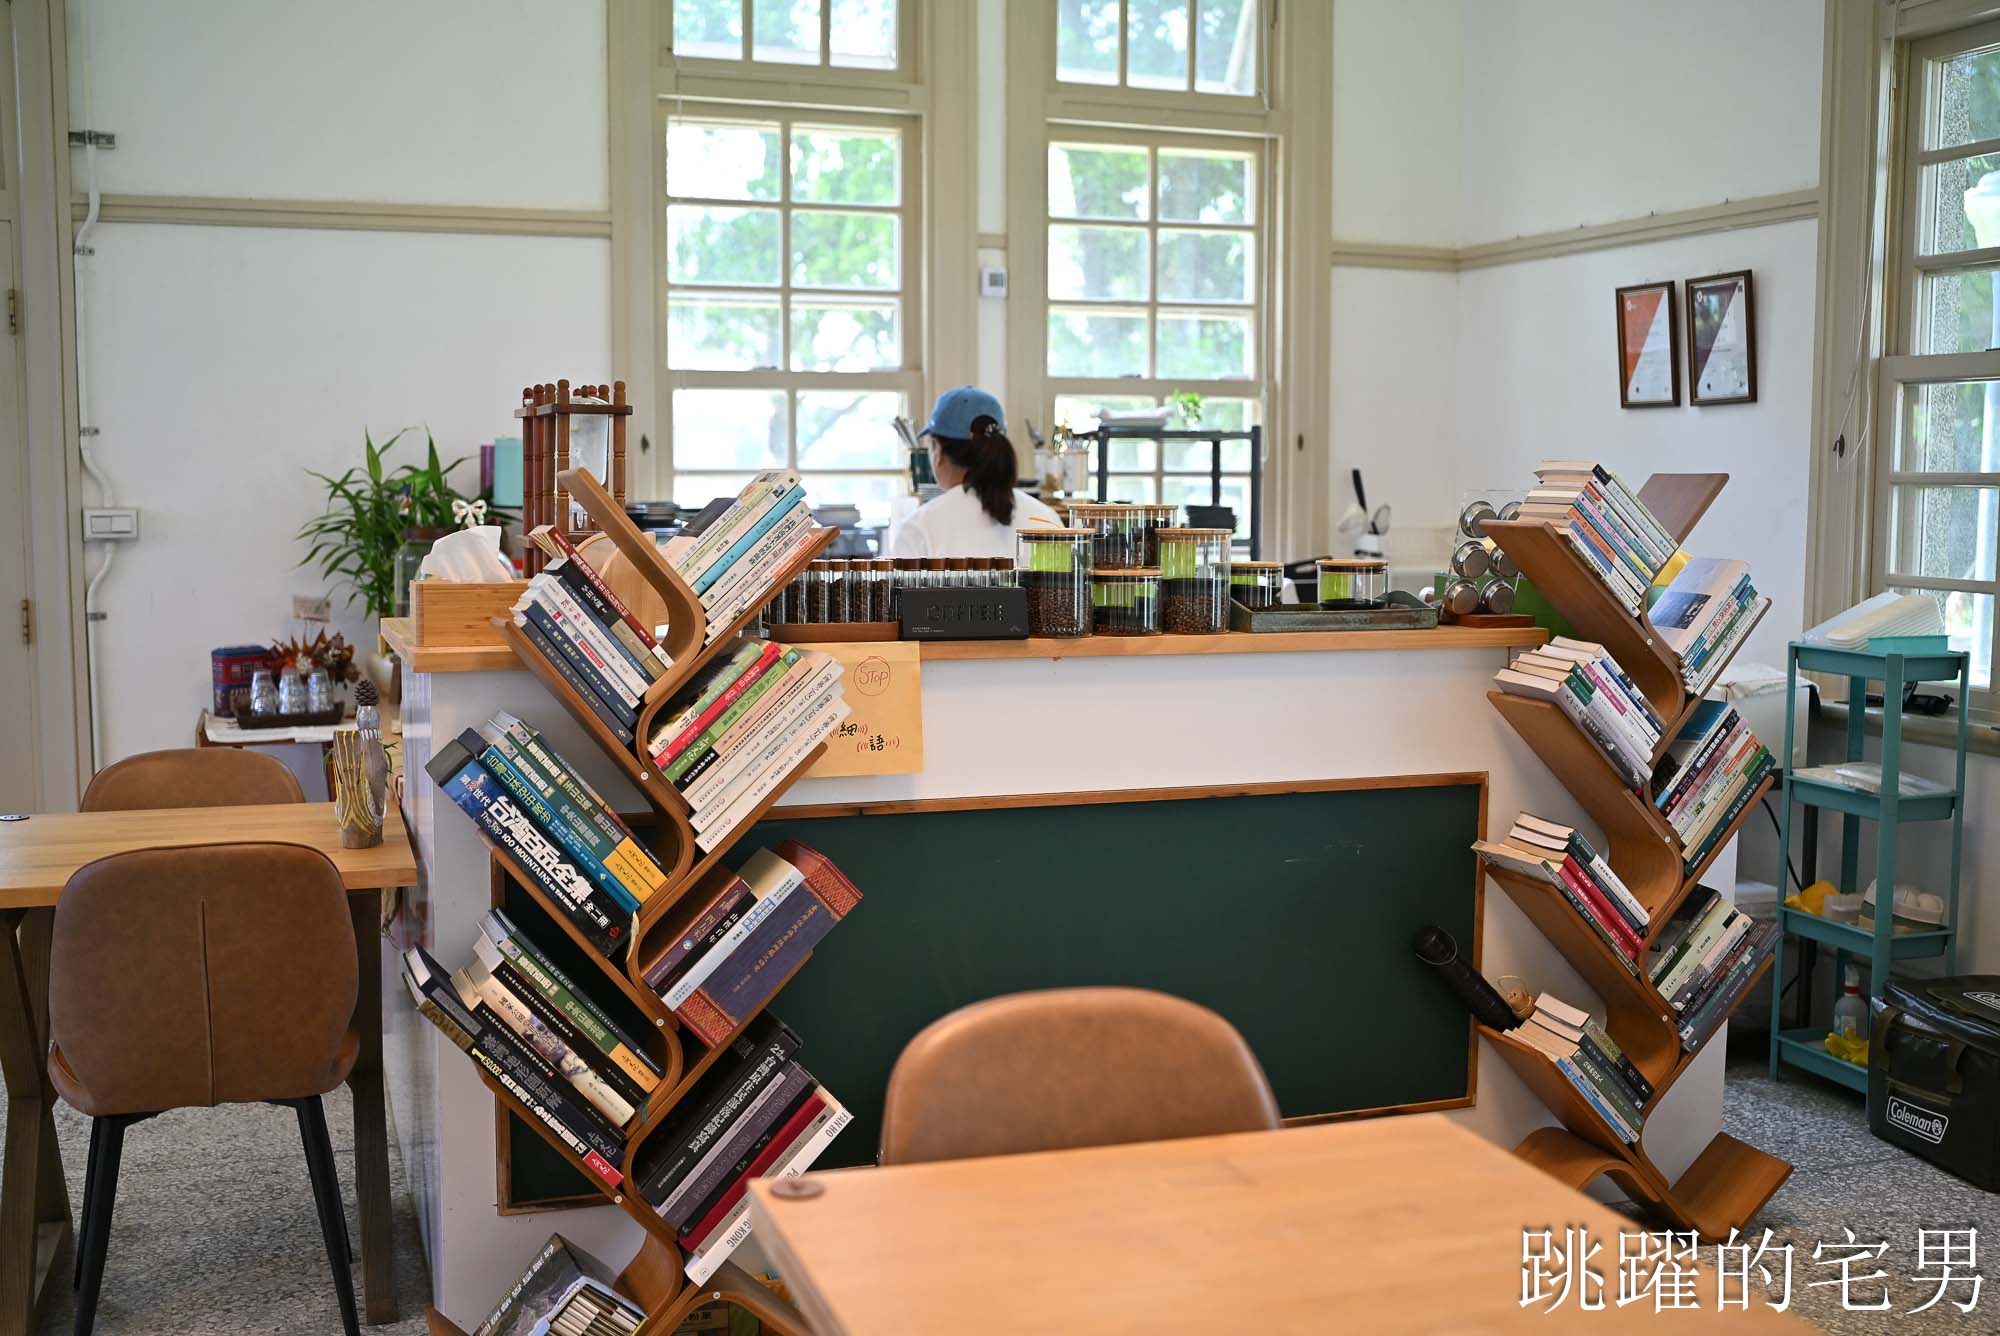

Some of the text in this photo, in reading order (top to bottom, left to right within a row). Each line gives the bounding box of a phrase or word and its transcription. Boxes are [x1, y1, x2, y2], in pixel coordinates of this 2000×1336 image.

[869, 735, 885, 752] 語
[458, 771, 493, 808] 第2世代
[484, 753, 554, 824] 台灣山林空中散步
[479, 810, 494, 825] The
[488, 820, 504, 836] Top
[500, 832, 516, 848] 100
[512, 844, 551, 885] MOUNTAINS
[554, 888, 576, 911] TAIWAN
[707, 911, 739, 944] 山徑百年
[479, 1032, 565, 1111] 臺灣地形圖新解
[1890, 1101, 1931, 1132] Coleman
[585, 1129, 618, 1159] 上河文化
[725, 1111, 849, 1248] FAN HO KONG
